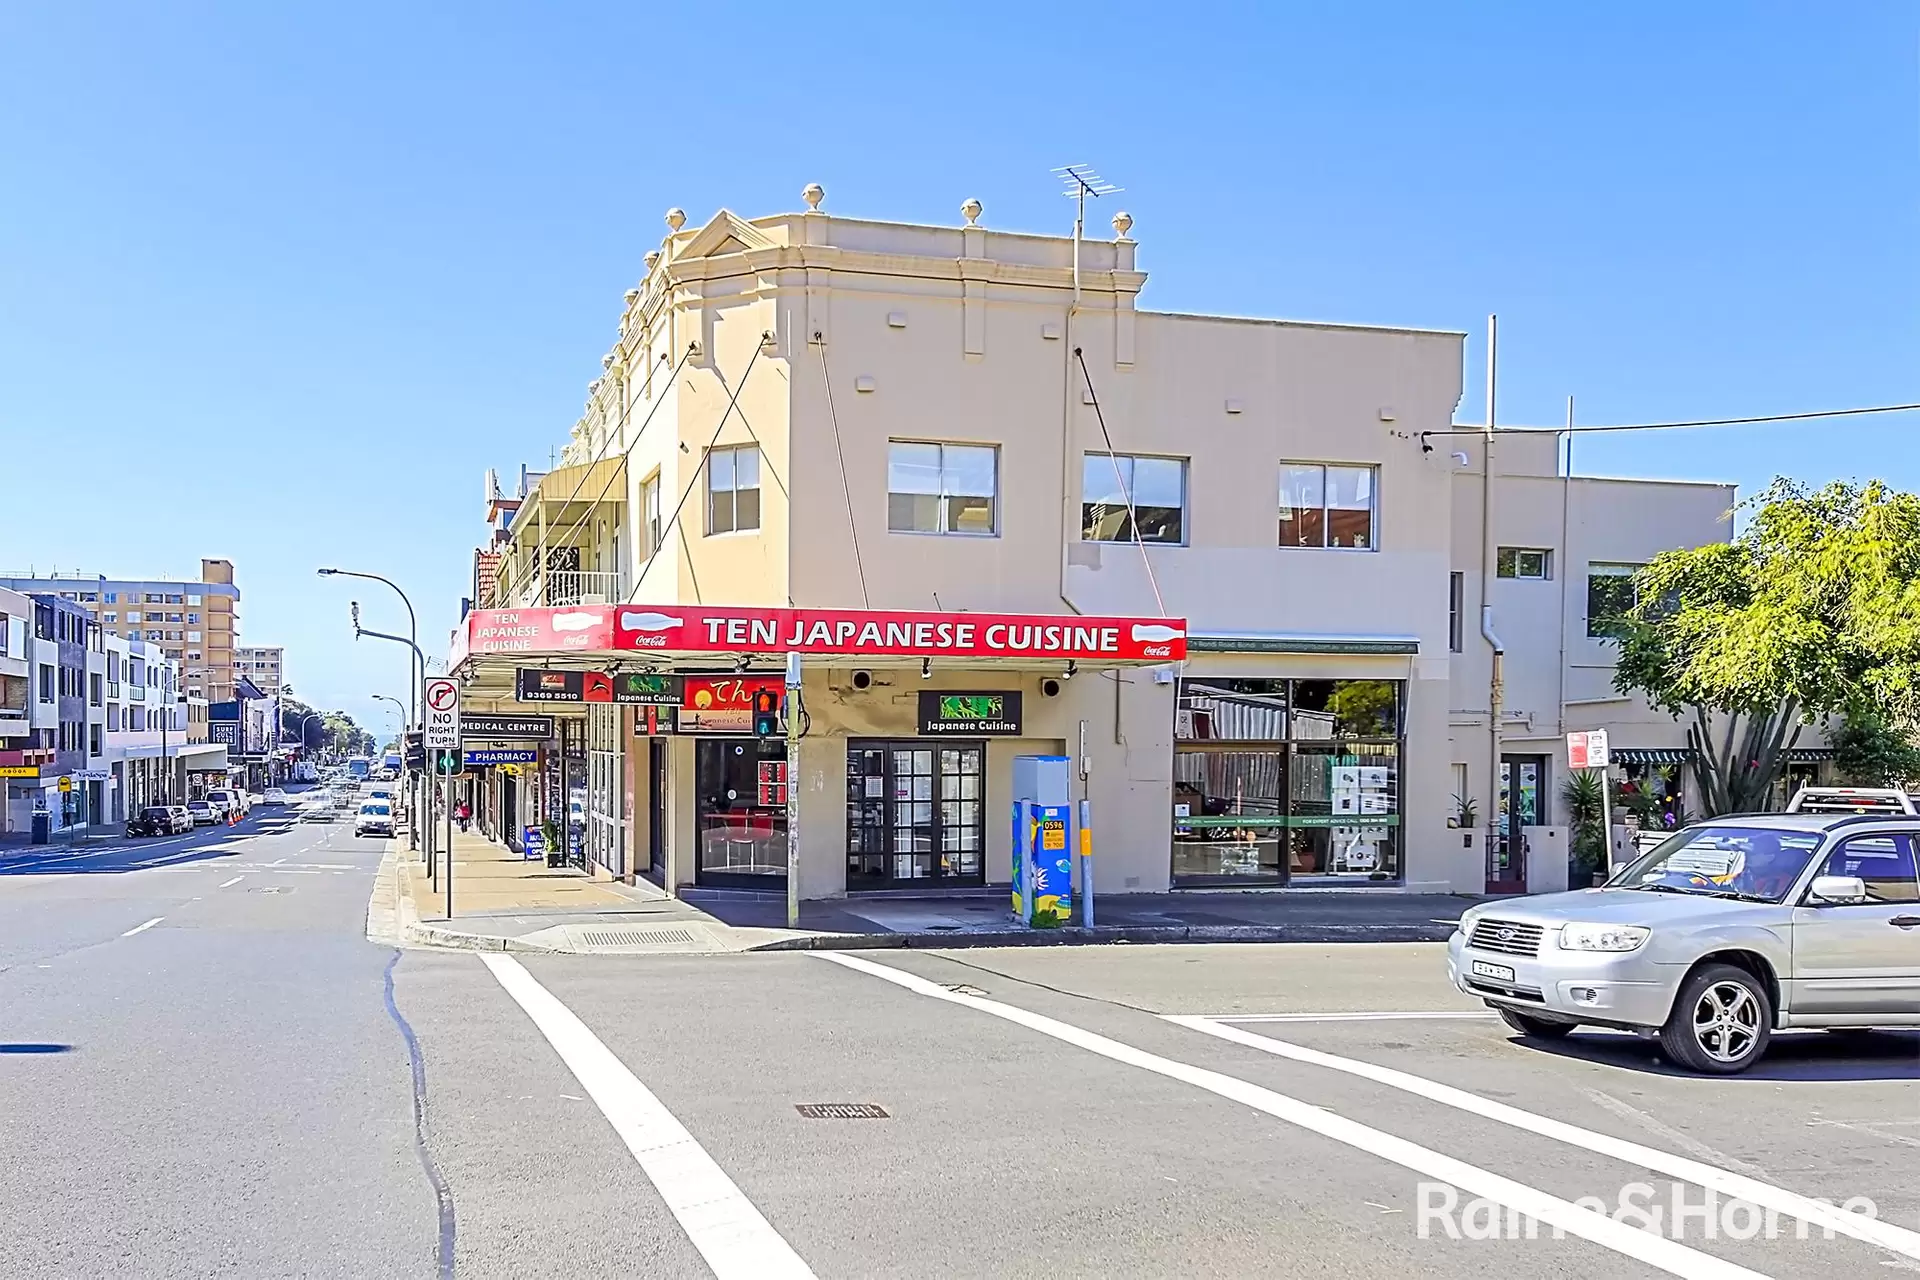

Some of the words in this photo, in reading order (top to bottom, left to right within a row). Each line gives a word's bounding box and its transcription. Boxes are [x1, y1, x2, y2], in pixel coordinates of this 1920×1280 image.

[494, 614, 519, 624] TEN
[475, 626, 539, 638] JAPANESE
[702, 617, 777, 645] TEN
[786, 620, 976, 649] JAPANESE
[984, 624, 1120, 652] CUISINE
[483, 640, 531, 650] CUISINE
[709, 680, 753, 702] てん
[617, 693, 652, 703] Japanese
[653, 695, 681, 703] Cuisine
[432, 713, 452, 724] NO
[428, 726, 456, 734] RIGHT
[461, 722, 504, 730] MEDICAL
[507, 723, 546, 732] CENTRE
[927, 721, 976, 731] Japanese
[978, 721, 1017, 731] Cuisine
[429, 736, 455, 744] TURN
[475, 752, 534, 762] PHARMACY
[1044, 821, 1063, 830] 0596
